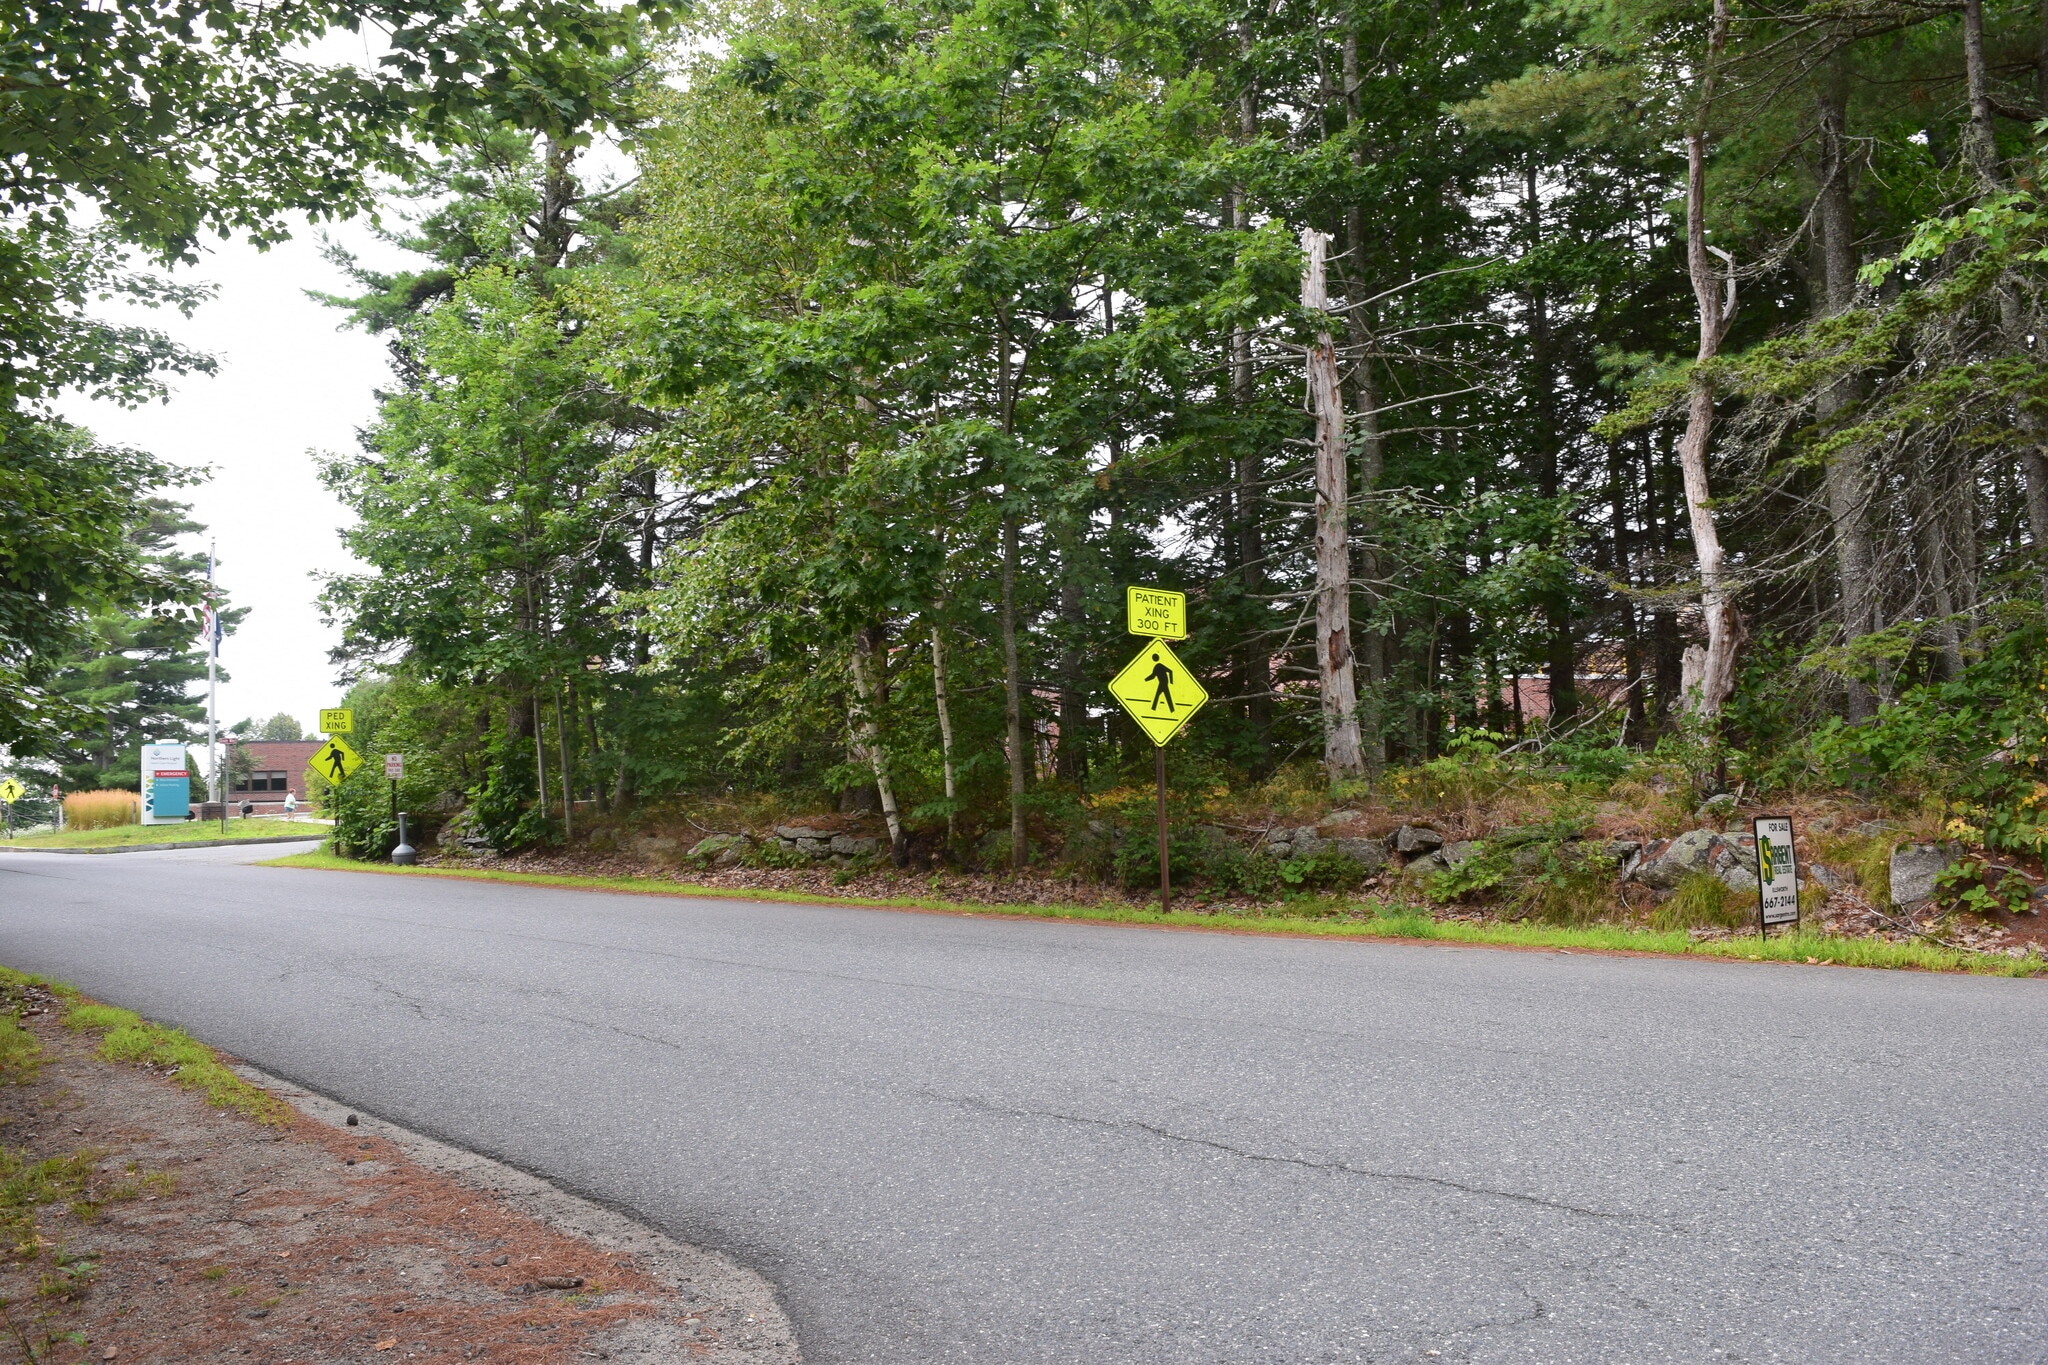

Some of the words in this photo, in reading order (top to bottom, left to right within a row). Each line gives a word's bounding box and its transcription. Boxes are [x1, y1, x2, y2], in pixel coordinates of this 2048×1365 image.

[1135, 593, 1178, 607] PATIENT
[1145, 607, 1169, 618] XING
[1137, 618, 1159, 630] 300
[1164, 622, 1177, 632] FT
[327, 712, 345, 720] PED
[326, 722, 347, 730] XING
[1768, 823, 1778, 831] FOR
[1778, 822, 1788, 831] SALE
[1759, 835, 1792, 885] SARGENT
[1774, 866, 1782, 874] REAL
[1782, 864, 1793, 873] ESTATE
[1764, 895, 1795, 909] 667-2144
